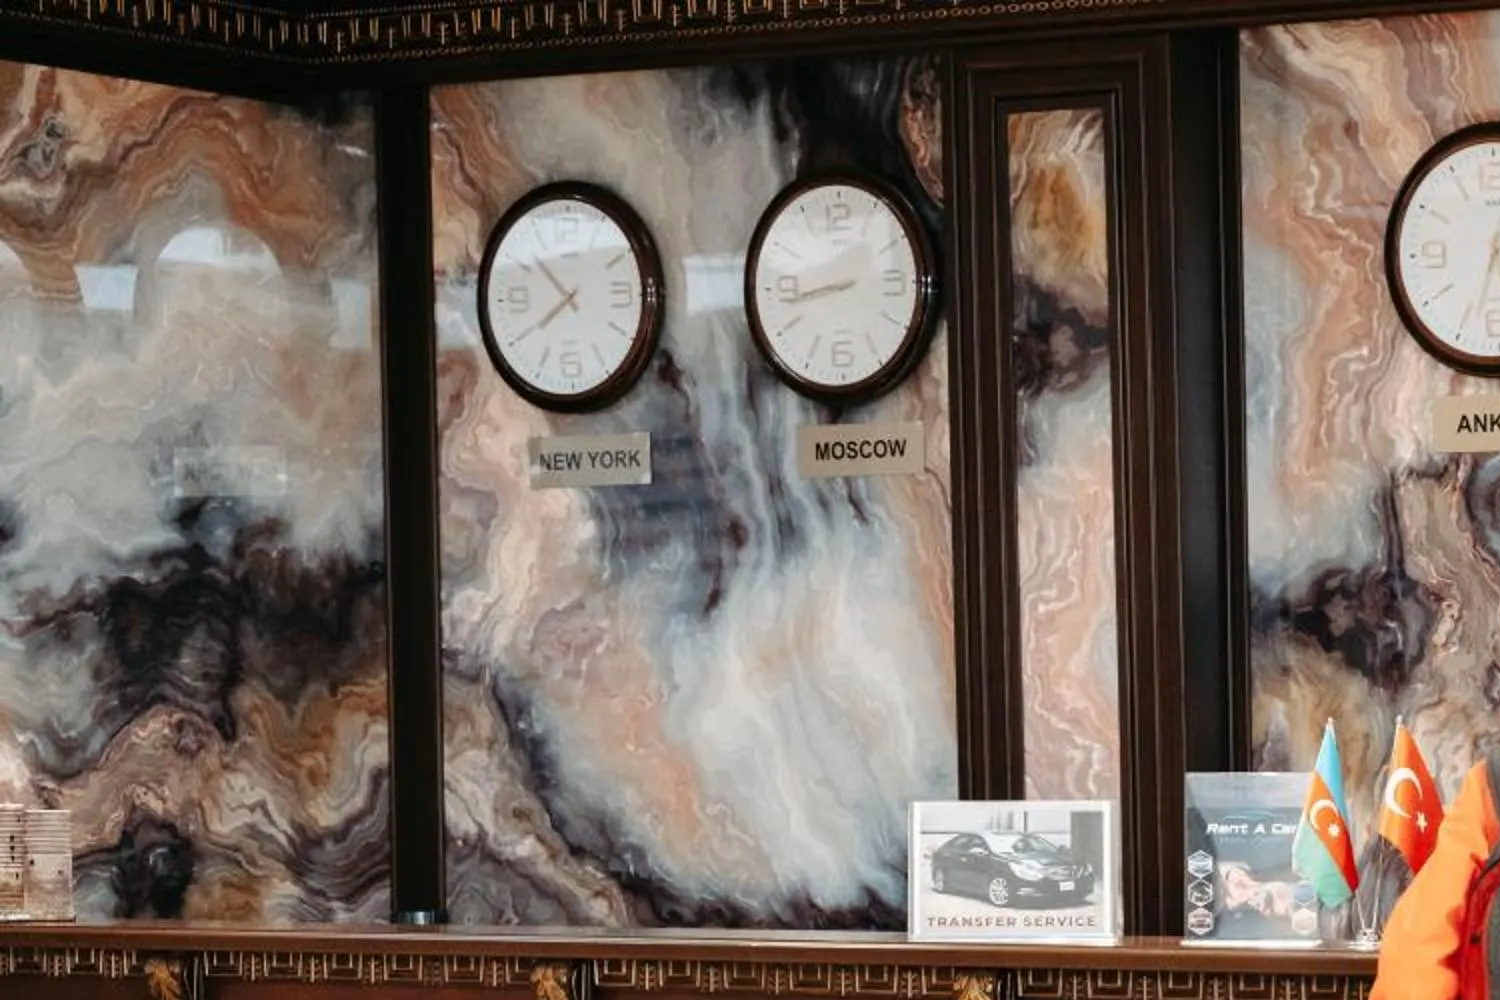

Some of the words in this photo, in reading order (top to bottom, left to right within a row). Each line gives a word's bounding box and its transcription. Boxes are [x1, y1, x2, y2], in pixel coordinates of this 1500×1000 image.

[825, 204, 853, 231] 12
[1422, 242, 1447, 269] 9
[610, 282, 633, 309] 3
[778, 275, 799, 303] 9
[883, 270, 907, 297] 3
[560, 352, 583, 378] 6
[832, 342, 854, 368] 6
[540, 450, 582, 471] NEW
[587, 448, 641, 469] YORK
[815, 439, 907, 461] MOSCOW
[1206, 823, 1249, 835] Rent
[1254, 823, 1266, 835] A
[928, 916, 1017, 928] TRANSFER
[1023, 915, 1097, 928] SERVICE
